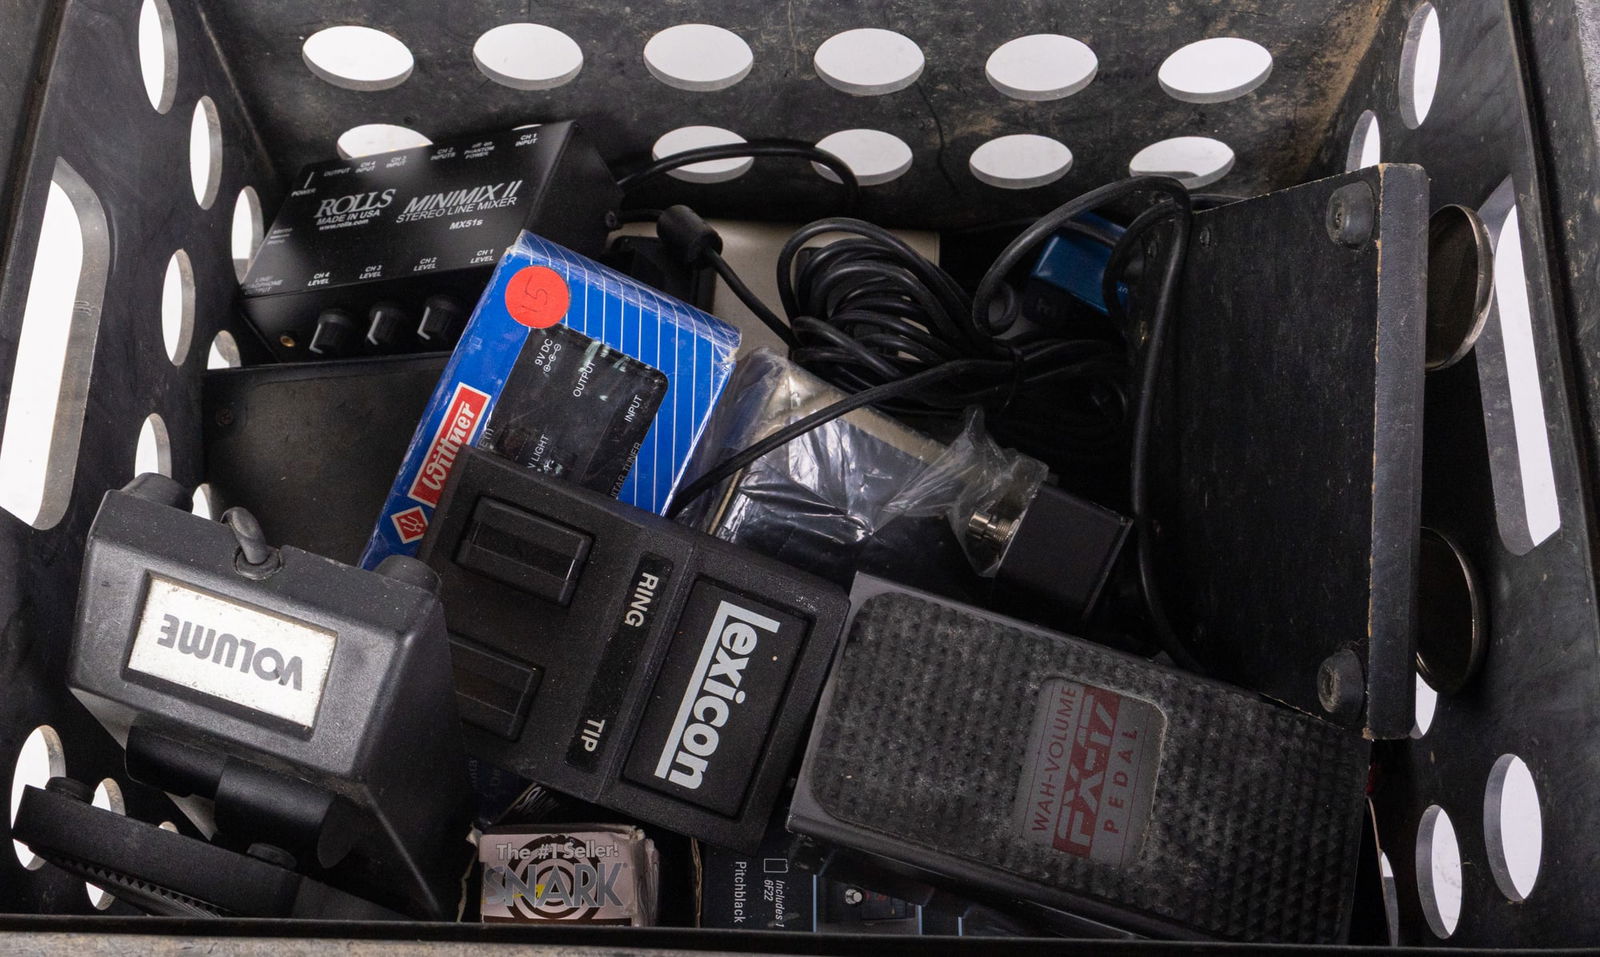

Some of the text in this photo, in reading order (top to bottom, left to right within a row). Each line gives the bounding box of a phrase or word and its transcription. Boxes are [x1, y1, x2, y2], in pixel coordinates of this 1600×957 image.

[514, 138, 538, 147] INPUT
[313, 188, 397, 218] ROLLS
[396, 197, 518, 224] STEREO LINE MIXER
[403, 180, 523, 214] MINIMIX II
[316, 209, 381, 226] MADE IN USA
[319, 219, 370, 231] www.rolls.com
[449, 219, 484, 230] MX51s
[413, 263, 437, 272] LEVEL
[470, 256, 494, 264] LEVEL
[307, 278, 329, 287] LEVEL
[359, 271, 382, 280] LEVEL
[534, 338, 553, 366] 9V DC
[573, 360, 597, 398] OUTPUT
[623, 394, 642, 423] INPUT
[421, 400, 475, 491] Wittner
[531, 434, 549, 462] LIGHT
[622, 442, 641, 472] TUNER
[624, 572, 659, 628] RING
[157, 613, 303, 691] VOLUME
[654, 600, 781, 790] lexicon
[581, 719, 606, 752] TIP
[1032, 686, 1077, 831] WAH-VOLUME
[1103, 729, 1138, 834] PEDAL
[496, 840, 620, 860] The #1 Seller!
[484, 862, 624, 908] SNARK
[734, 861, 747, 924] Pitchblack
[764, 879, 774, 901] 6F22
[775, 880, 786, 919] Includes
